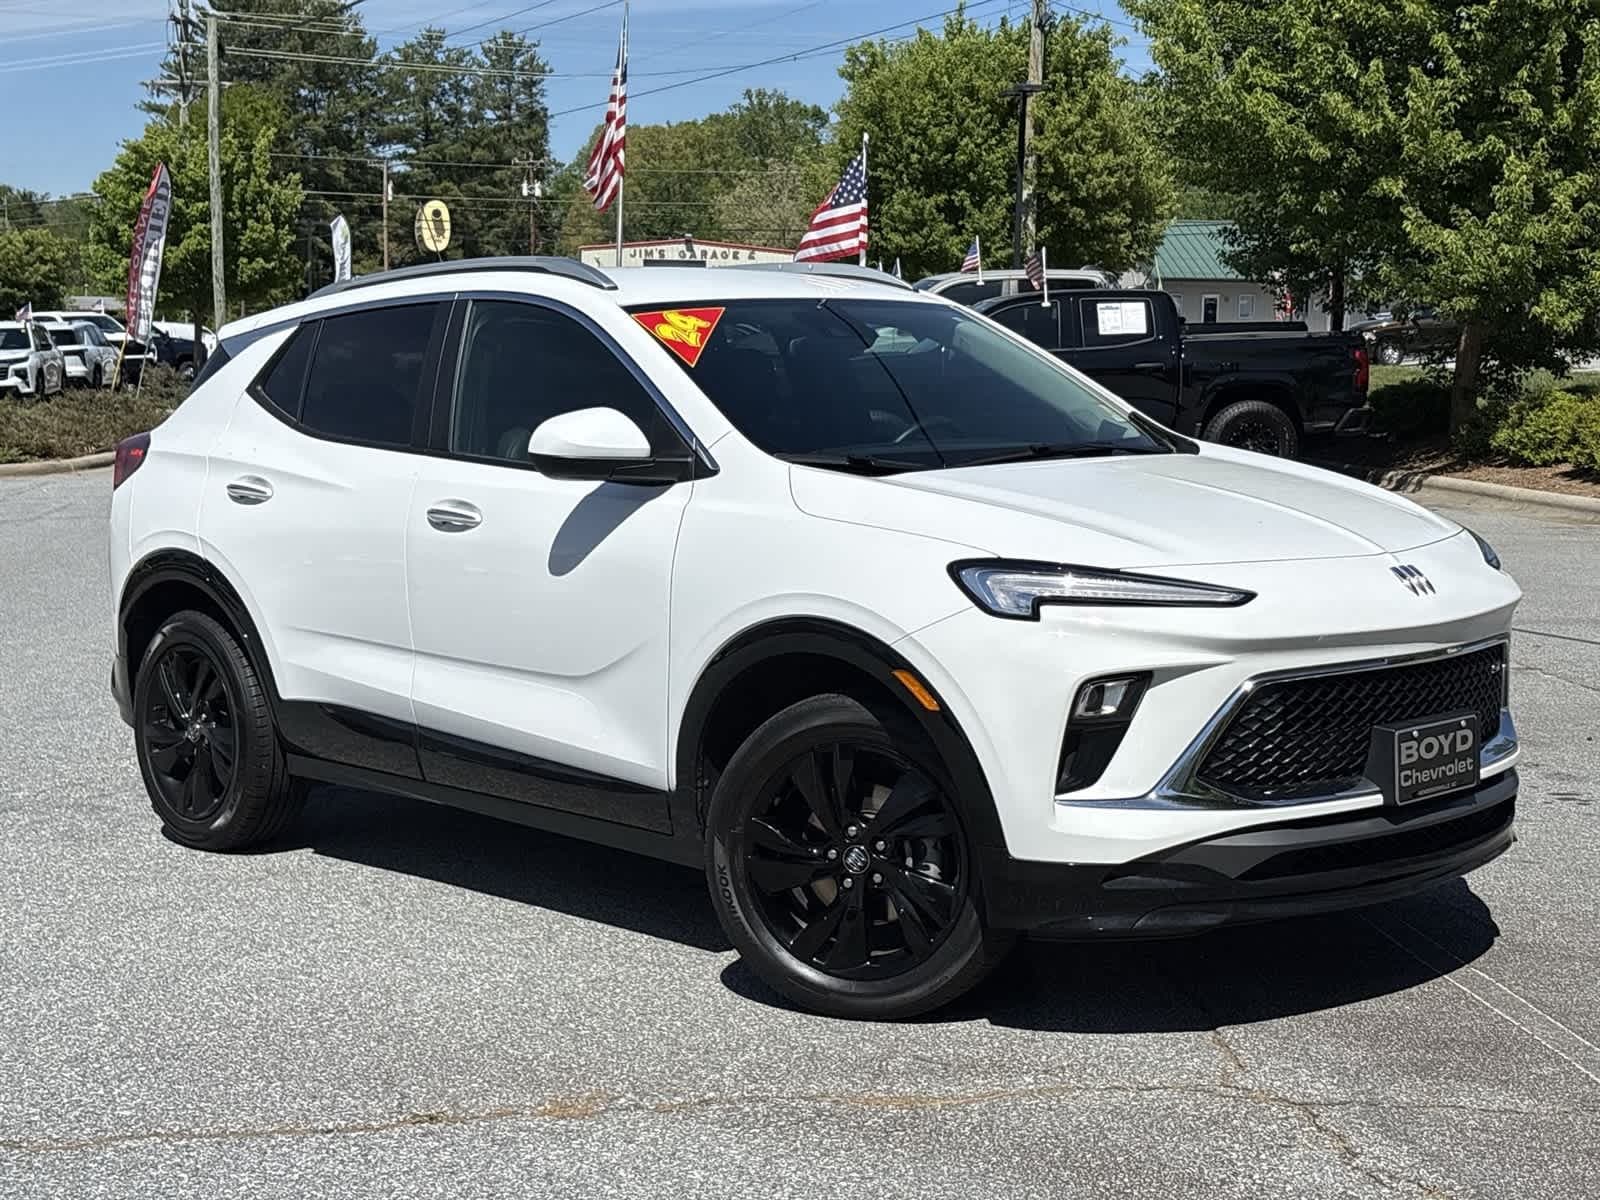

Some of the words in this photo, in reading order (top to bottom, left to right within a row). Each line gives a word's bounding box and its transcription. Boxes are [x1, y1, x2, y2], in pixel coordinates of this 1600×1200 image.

[629, 248, 666, 259] JIM'S
[678, 249, 740, 260] GARAGE
[655, 311, 711, 347] 24
[1400, 729, 1474, 766] BOYD
[1400, 757, 1475, 788] Chevrolet
